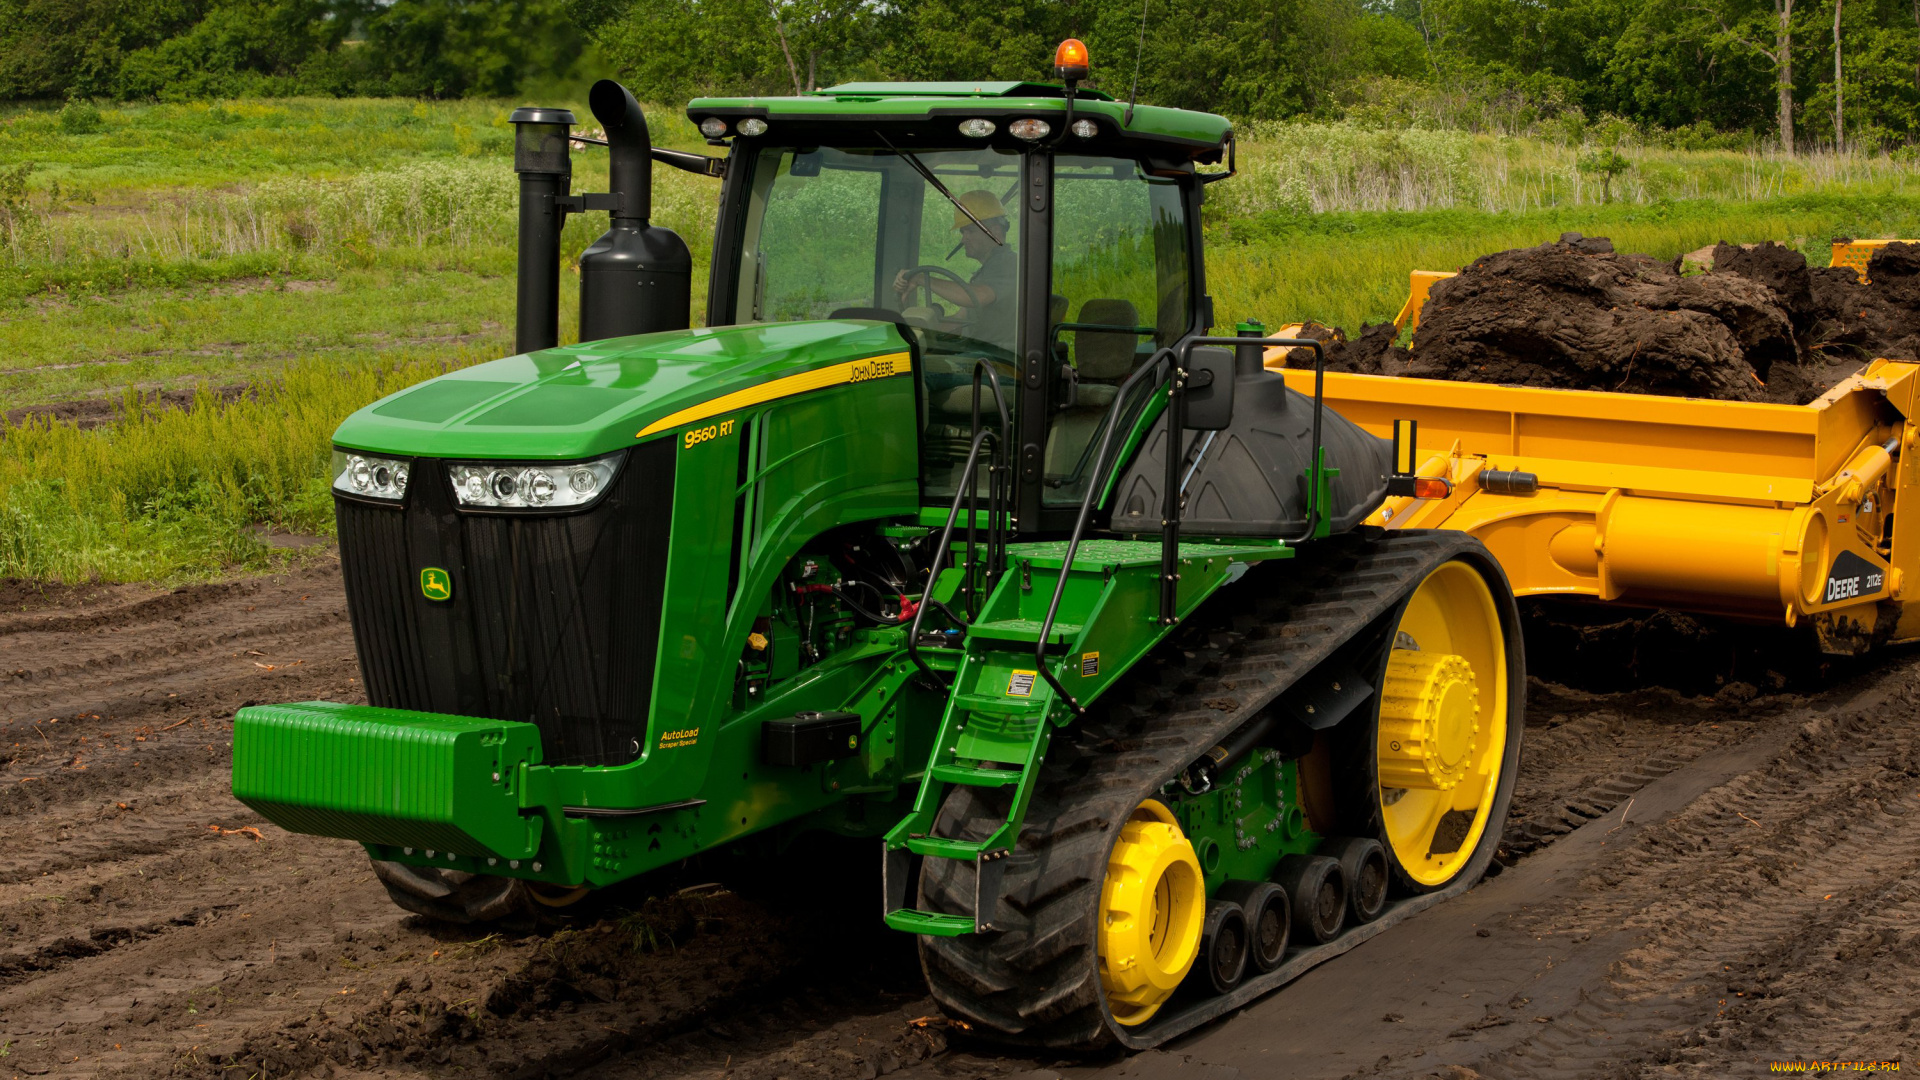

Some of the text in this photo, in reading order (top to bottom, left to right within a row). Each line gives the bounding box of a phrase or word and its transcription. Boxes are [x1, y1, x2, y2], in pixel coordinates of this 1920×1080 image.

[850, 360, 895, 381] JOHN DEERE
[684, 419, 735, 449] 9560 RT
[1827, 573, 1882, 601] DEERE 2112E
[660, 727, 699, 741] AutoLoad
